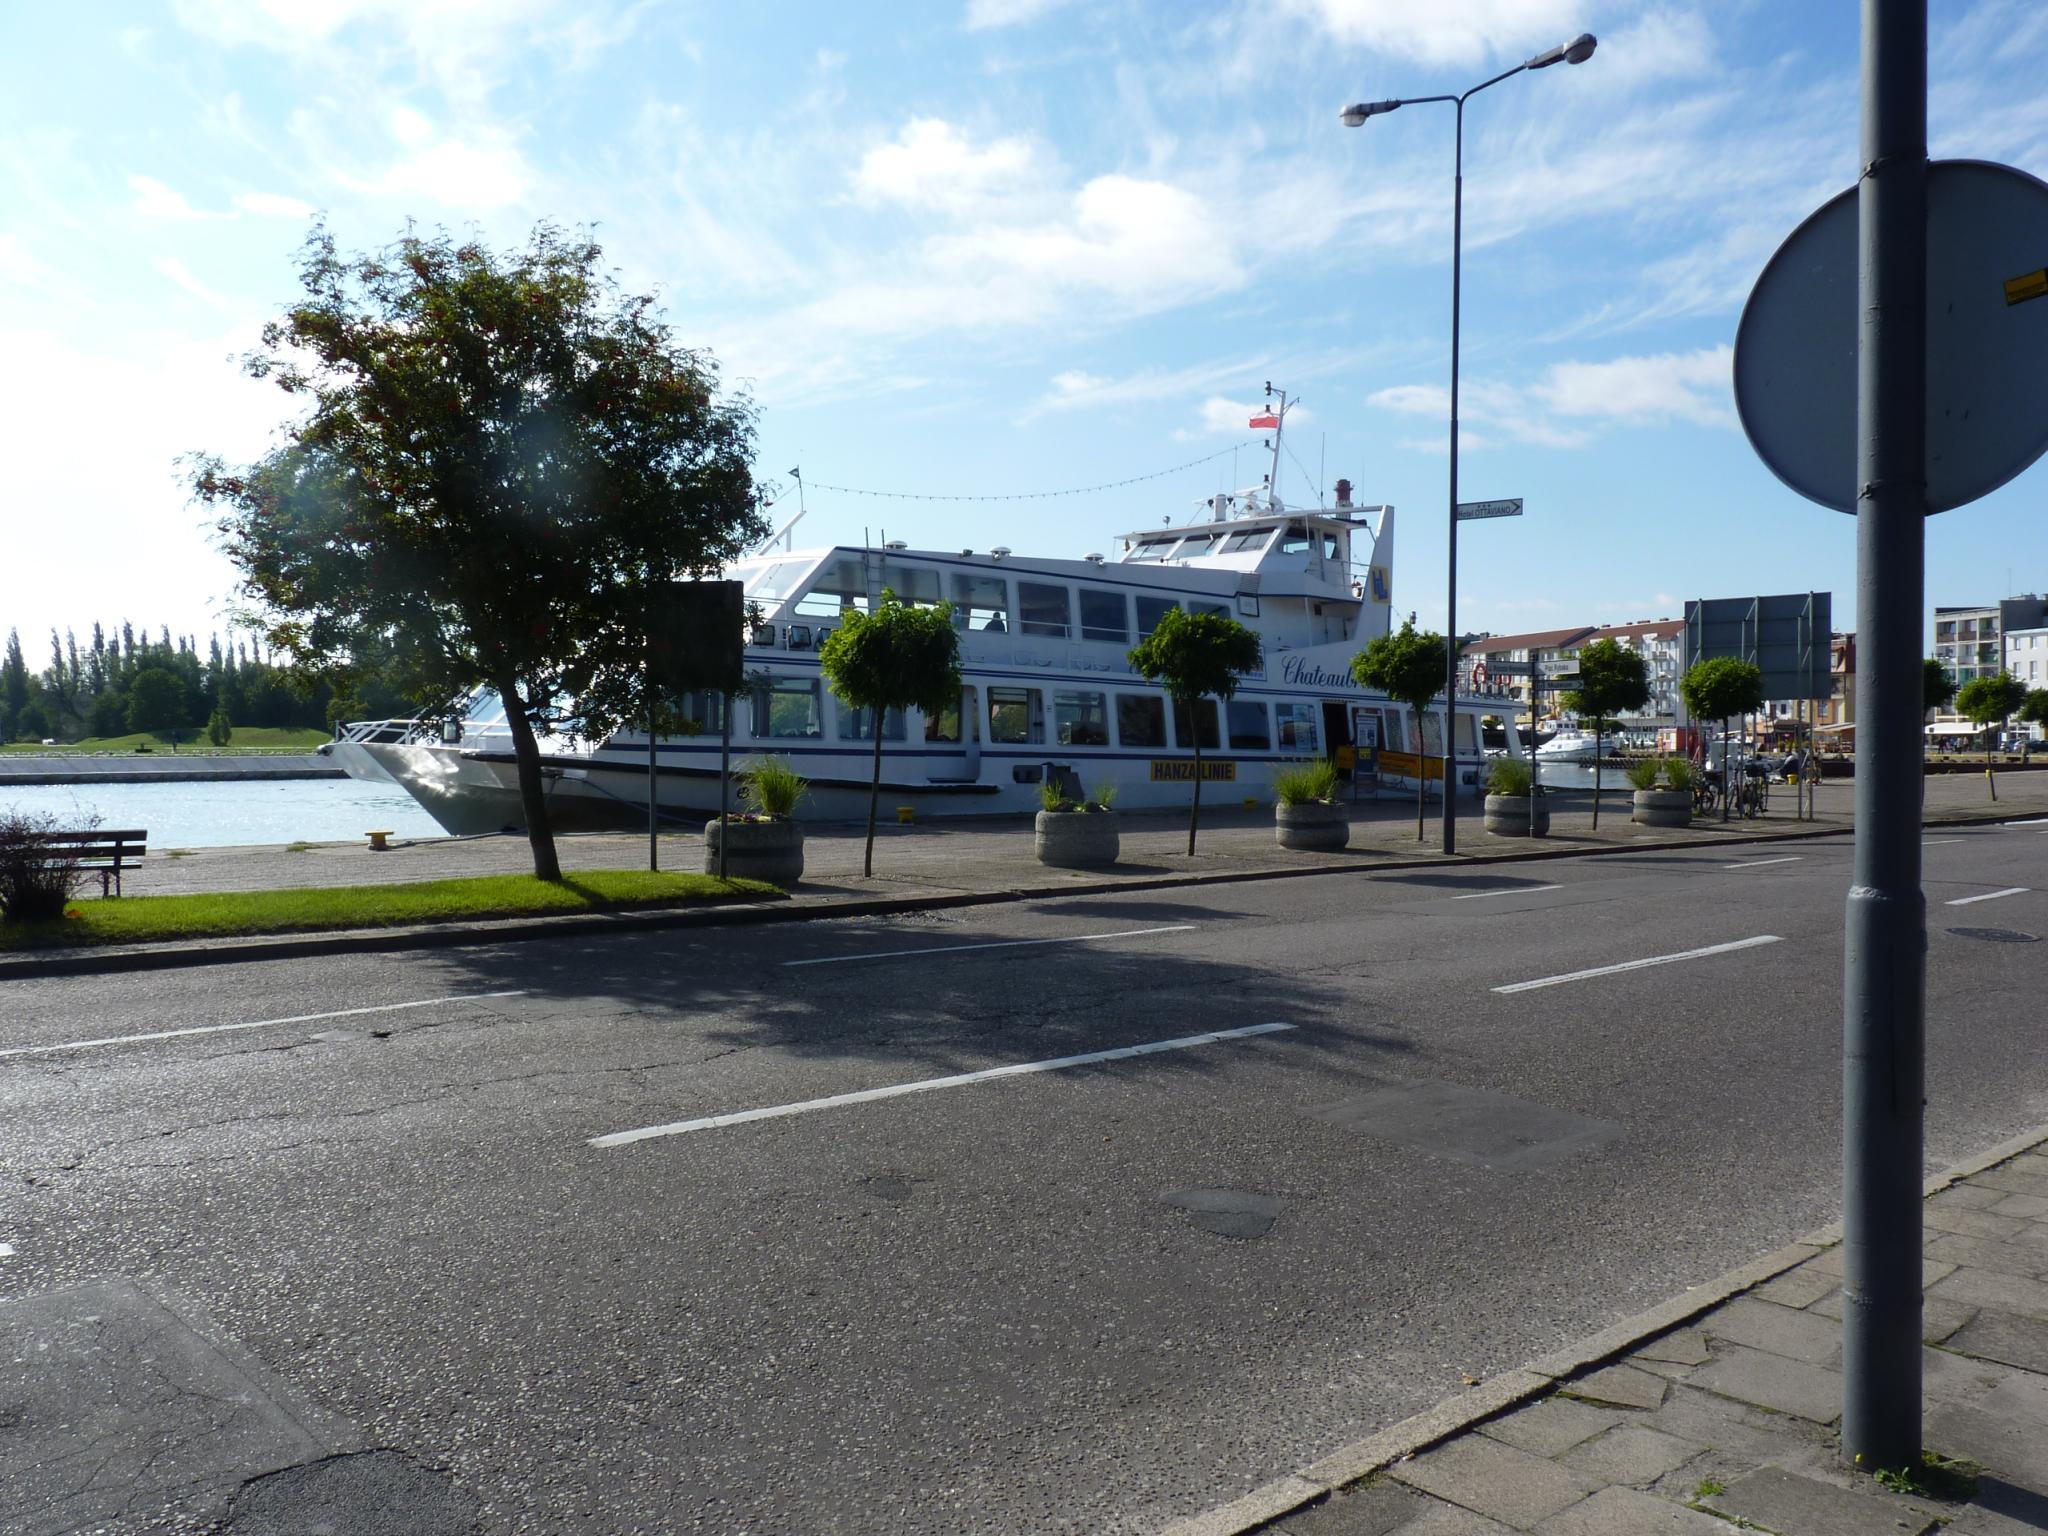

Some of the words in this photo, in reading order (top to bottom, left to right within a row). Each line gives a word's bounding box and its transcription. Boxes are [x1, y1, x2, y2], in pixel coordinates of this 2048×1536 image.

[1475, 505, 1511, 516] OTTAVIANO
[1154, 762, 1196, 780] HANZA
[1200, 762, 1232, 780] LINIE
